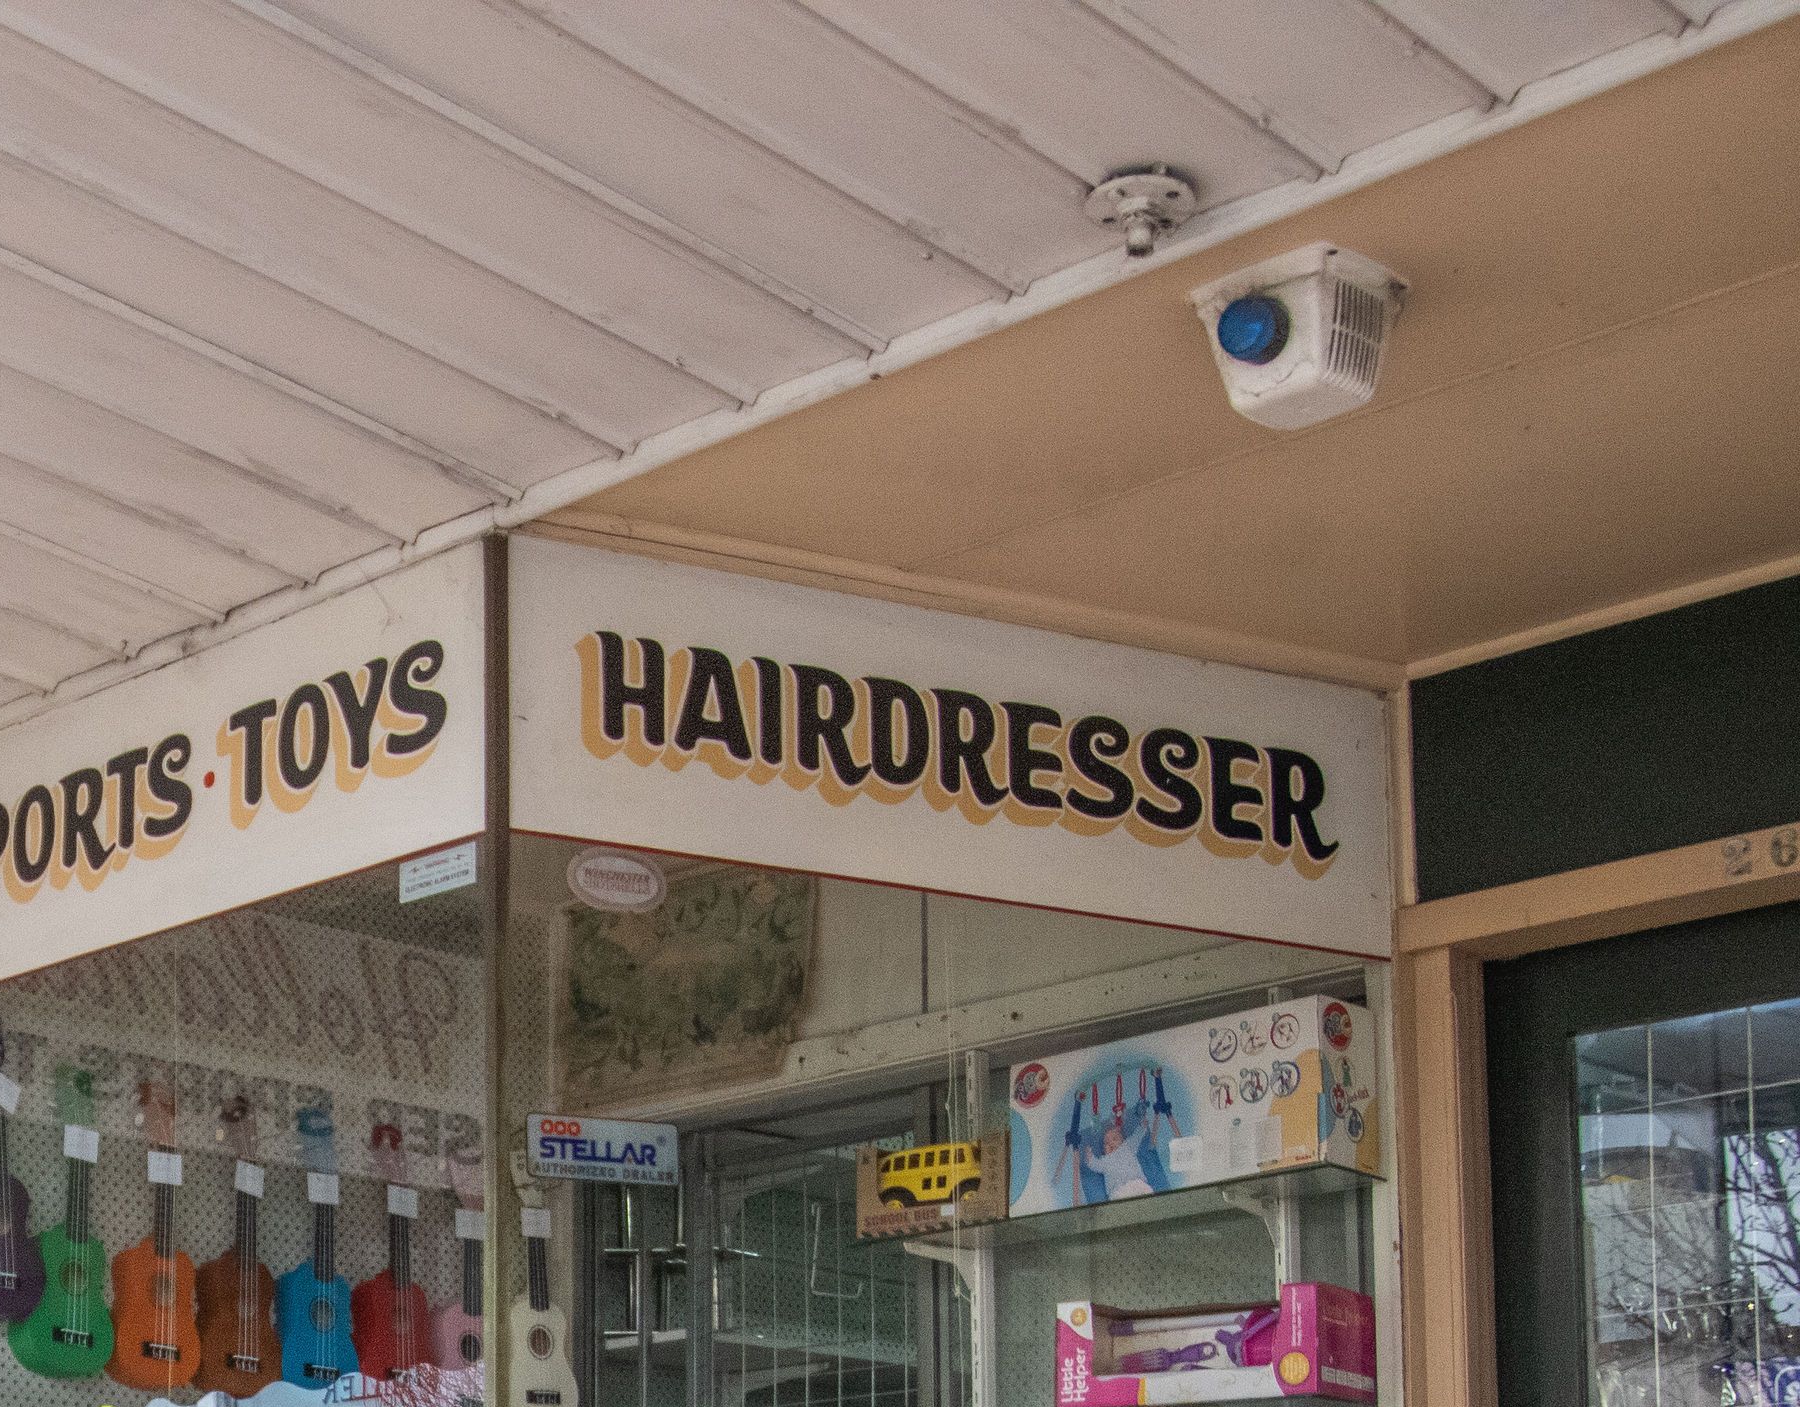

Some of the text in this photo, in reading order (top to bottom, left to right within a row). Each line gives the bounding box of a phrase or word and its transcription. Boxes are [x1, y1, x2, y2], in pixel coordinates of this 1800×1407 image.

[229, 638, 448, 806] TOYS
[596, 630, 1340, 861] HAIRDRESSER
[533, 1161, 675, 1184] AUTHORIZED DEALER
[539, 1137, 657, 1166] STELLAR
[863, 1207, 938, 1229] SCHOOL BUS
[1072, 1347, 1088, 1402] Helper
